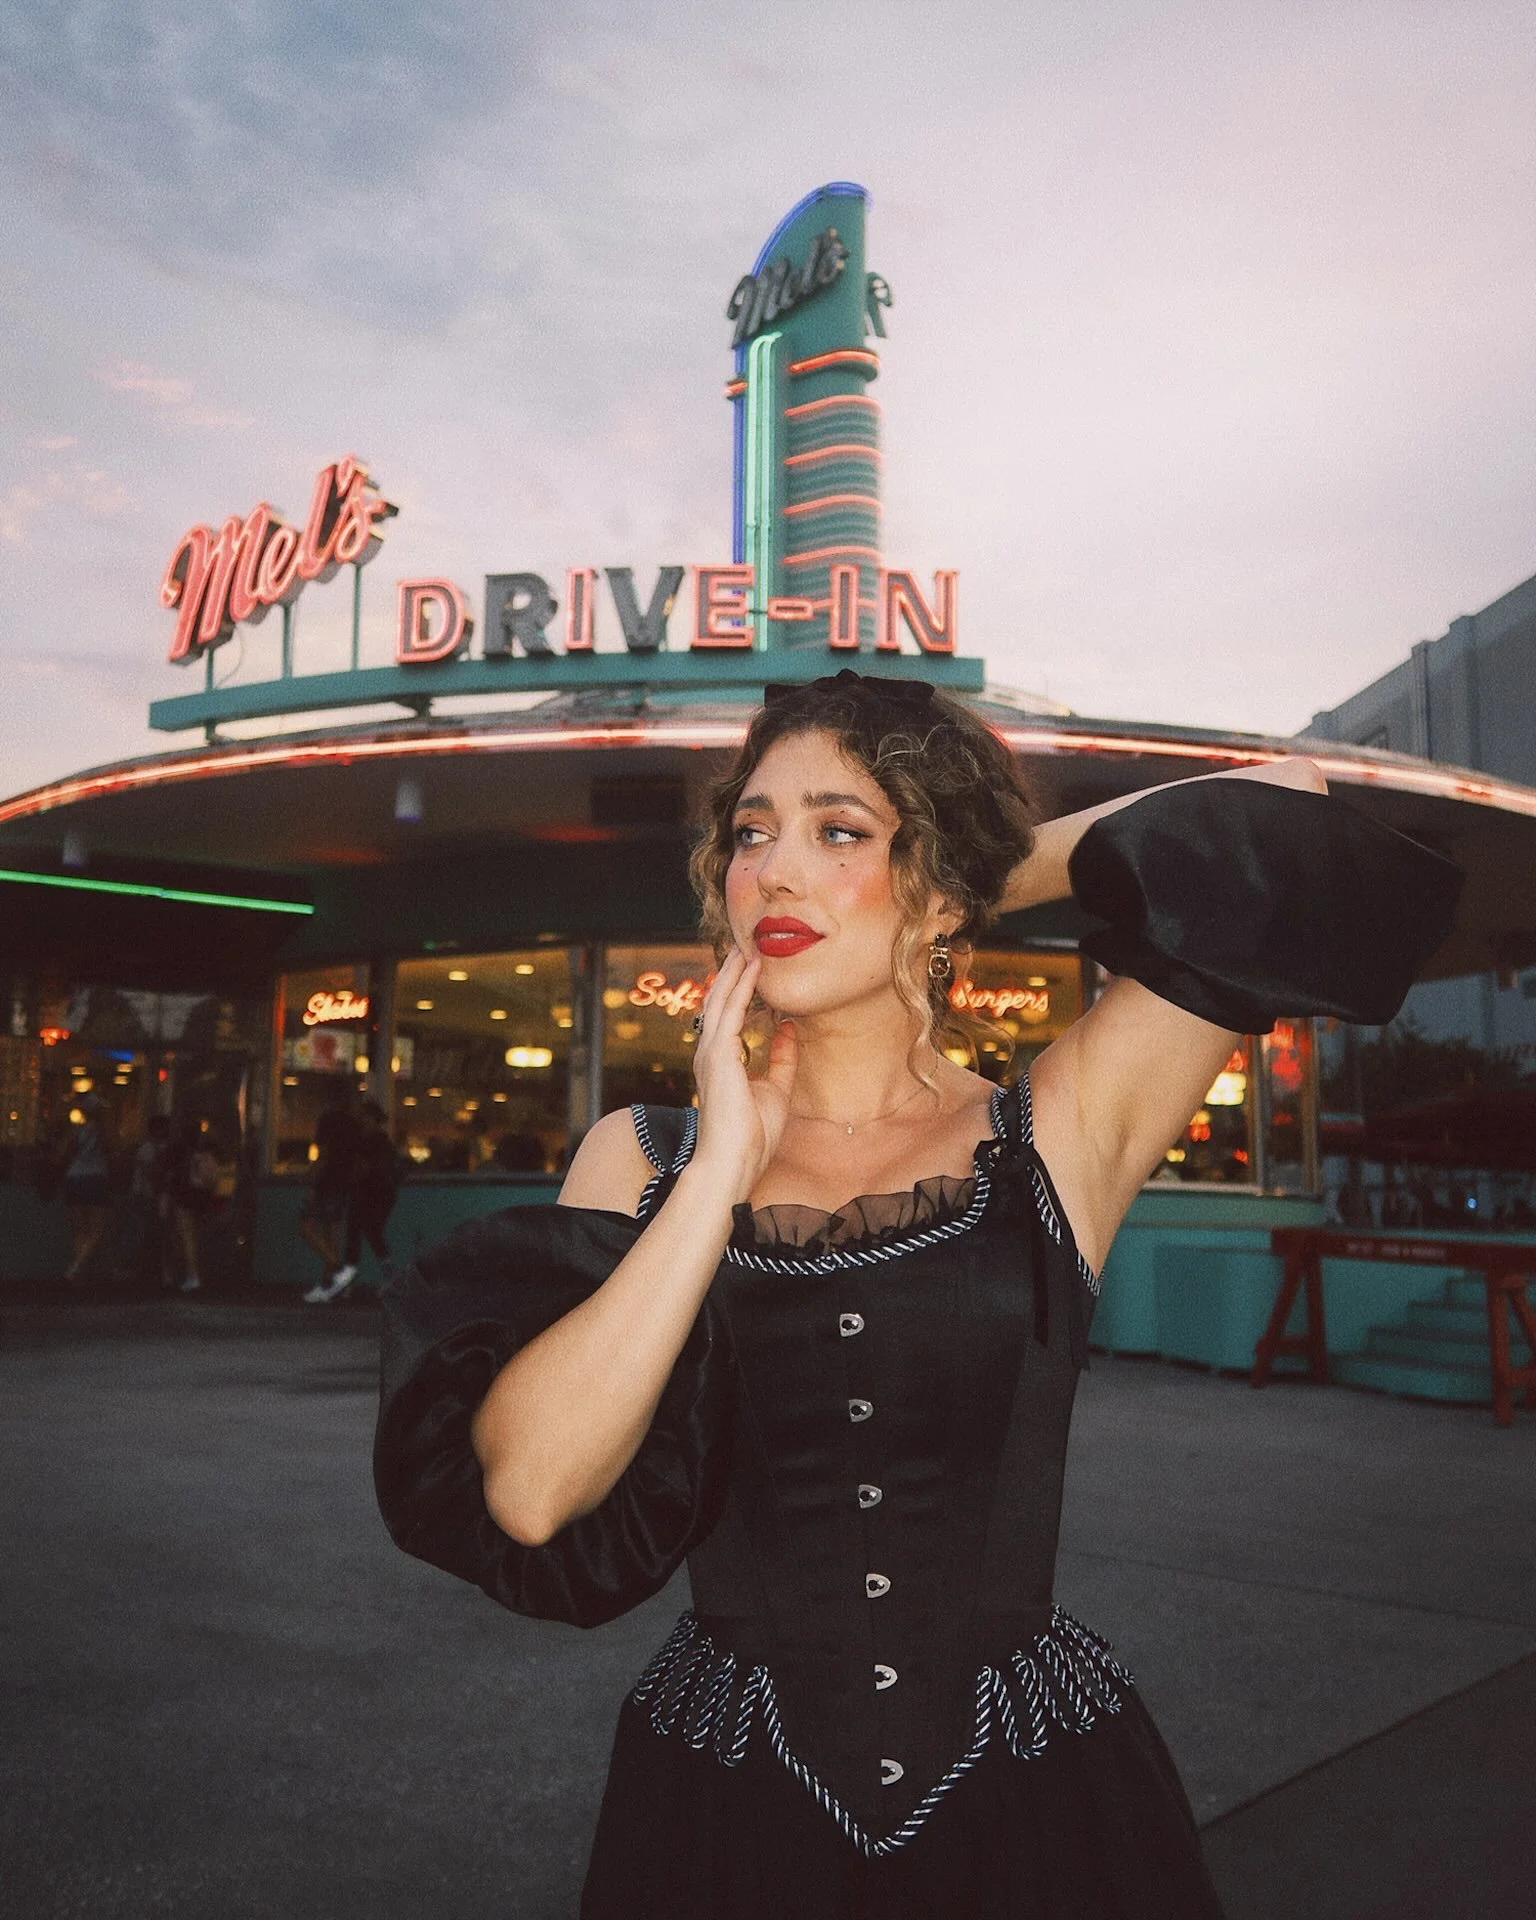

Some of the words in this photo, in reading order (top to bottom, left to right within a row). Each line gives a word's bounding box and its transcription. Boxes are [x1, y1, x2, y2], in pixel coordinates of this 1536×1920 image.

[728, 226, 849, 349] Mel's
[161, 453, 392, 664] Mel's
[396, 564, 960, 662] DRIVE-IN
